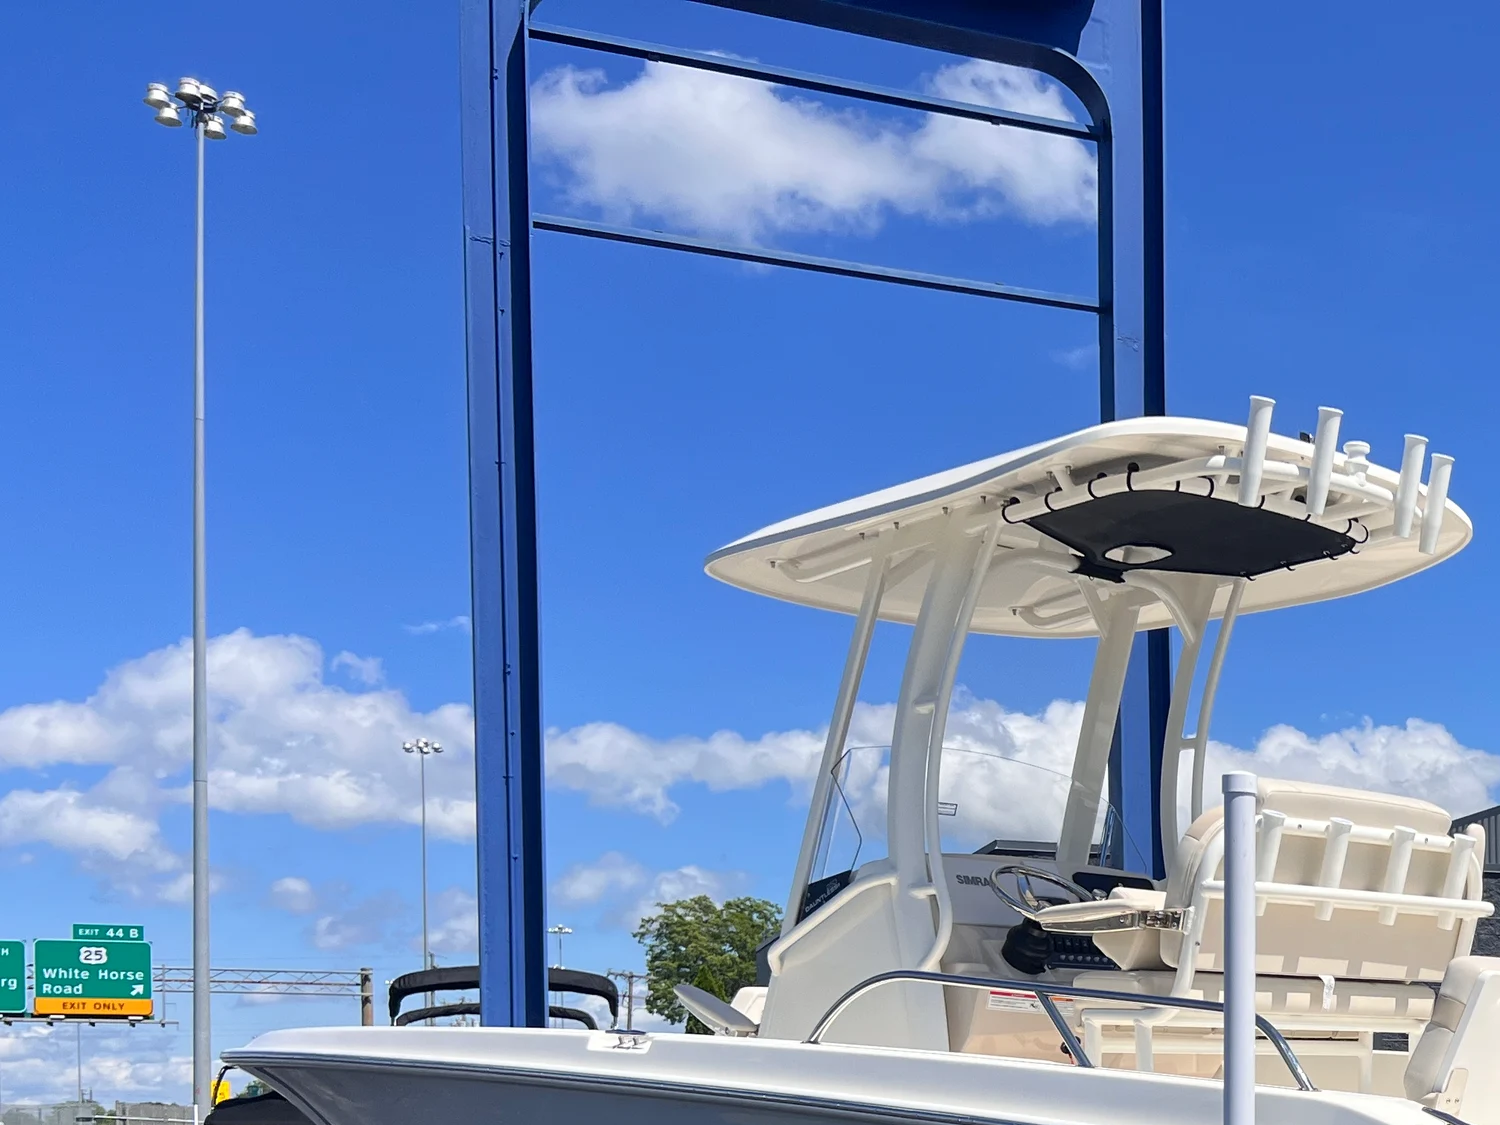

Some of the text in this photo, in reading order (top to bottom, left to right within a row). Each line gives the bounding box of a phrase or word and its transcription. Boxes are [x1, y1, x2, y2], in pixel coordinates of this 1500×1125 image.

[956, 874, 992, 887] SIMRA
[78, 928, 139, 938] EXIT 44 B
[83, 950, 103, 961] 25
[42, 968, 144, 981] White Horse
[42, 983, 83, 995] Road
[62, 1001, 125, 1011] EXIT ONLY
